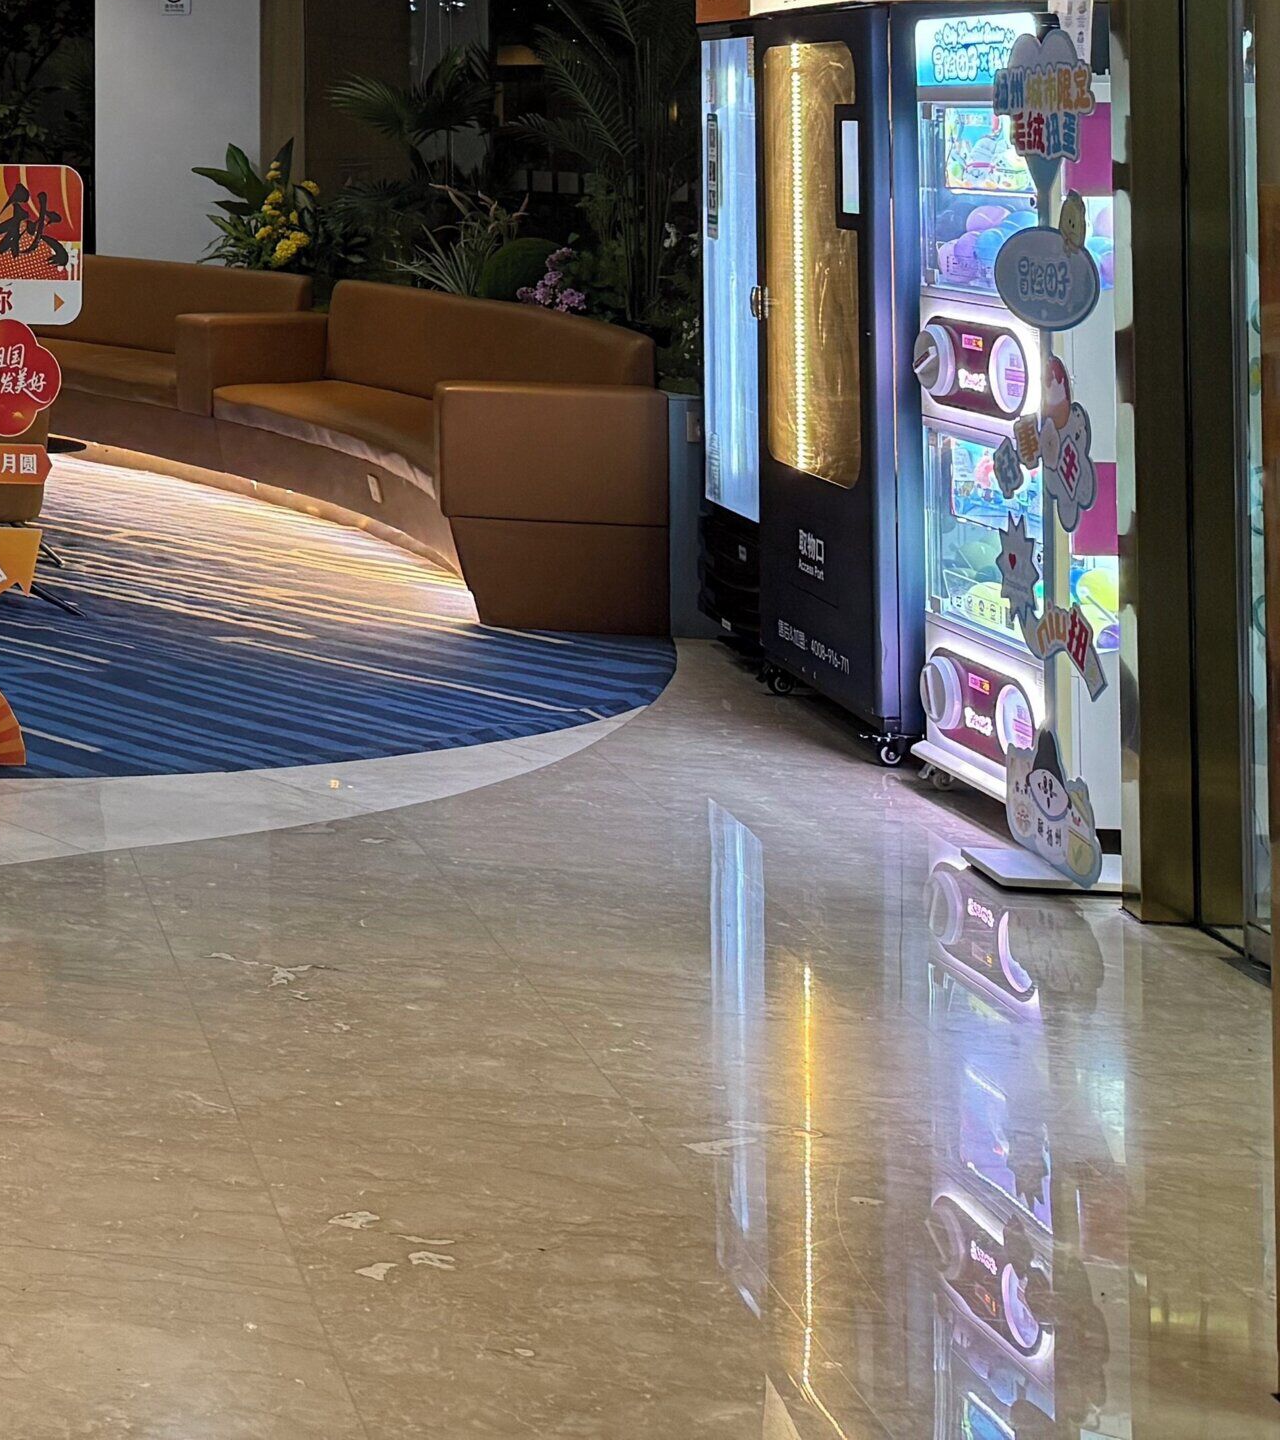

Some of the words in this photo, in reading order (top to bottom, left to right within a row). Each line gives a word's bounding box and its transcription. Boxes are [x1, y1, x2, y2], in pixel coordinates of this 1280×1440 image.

[1012, 111, 1077, 156] 毛绒扭蛋
[798, 528, 825, 564] 取物口
